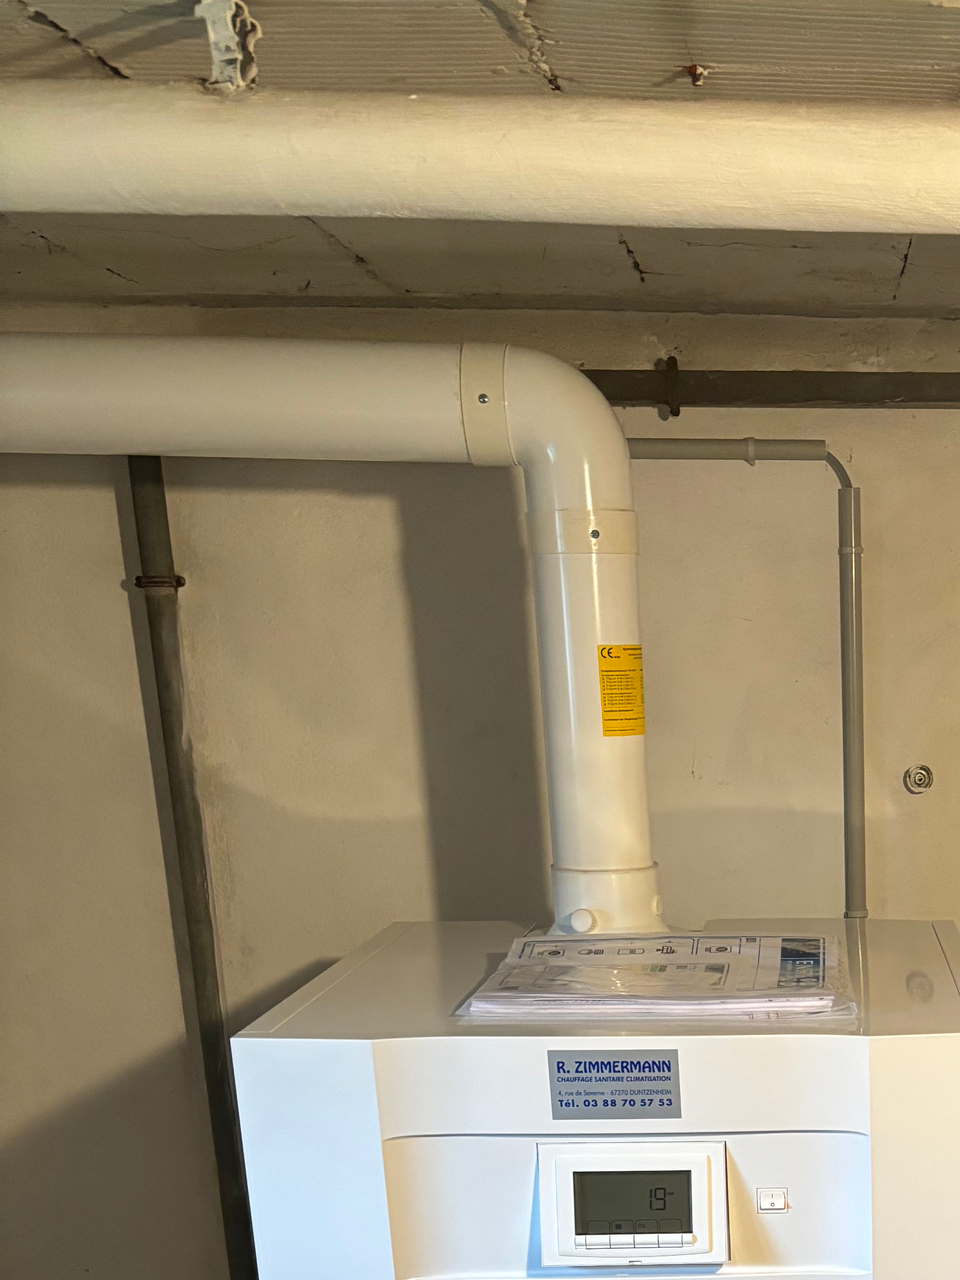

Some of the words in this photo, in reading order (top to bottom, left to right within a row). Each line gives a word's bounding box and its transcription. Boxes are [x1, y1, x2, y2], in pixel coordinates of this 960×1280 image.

[557, 1061, 571, 1074] R.
[574, 1060, 671, 1073] ZIMMERMANN
[558, 1099, 579, 1107] Tél.
[583, 1099, 598, 1107] 03
[602, 1099, 617, 1107] 88
[621, 1099, 636, 1107] 70
[640, 1098, 654, 1107] 57
[658, 1098, 673, 1106] 53
